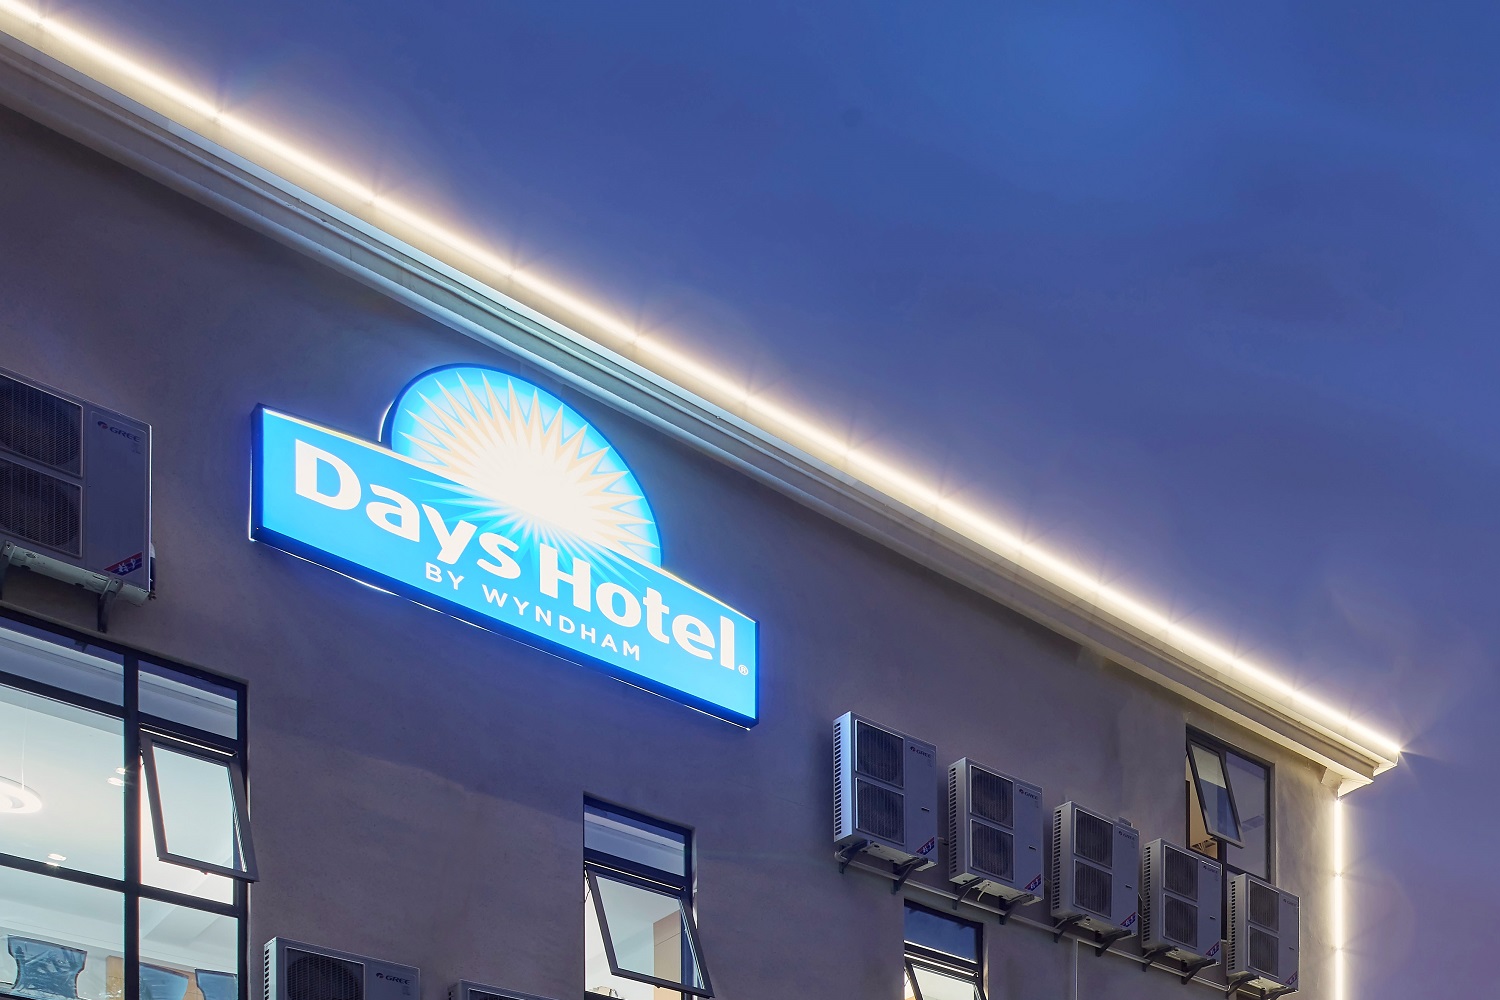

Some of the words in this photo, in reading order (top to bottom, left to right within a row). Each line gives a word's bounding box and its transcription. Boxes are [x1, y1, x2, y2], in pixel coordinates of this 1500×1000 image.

[109, 426, 141, 443] GREE
[294, 438, 522, 580] Days
[425, 560, 466, 591] BY
[481, 583, 641, 662] WYNDHAM
[385, 975, 411, 986] GREE
